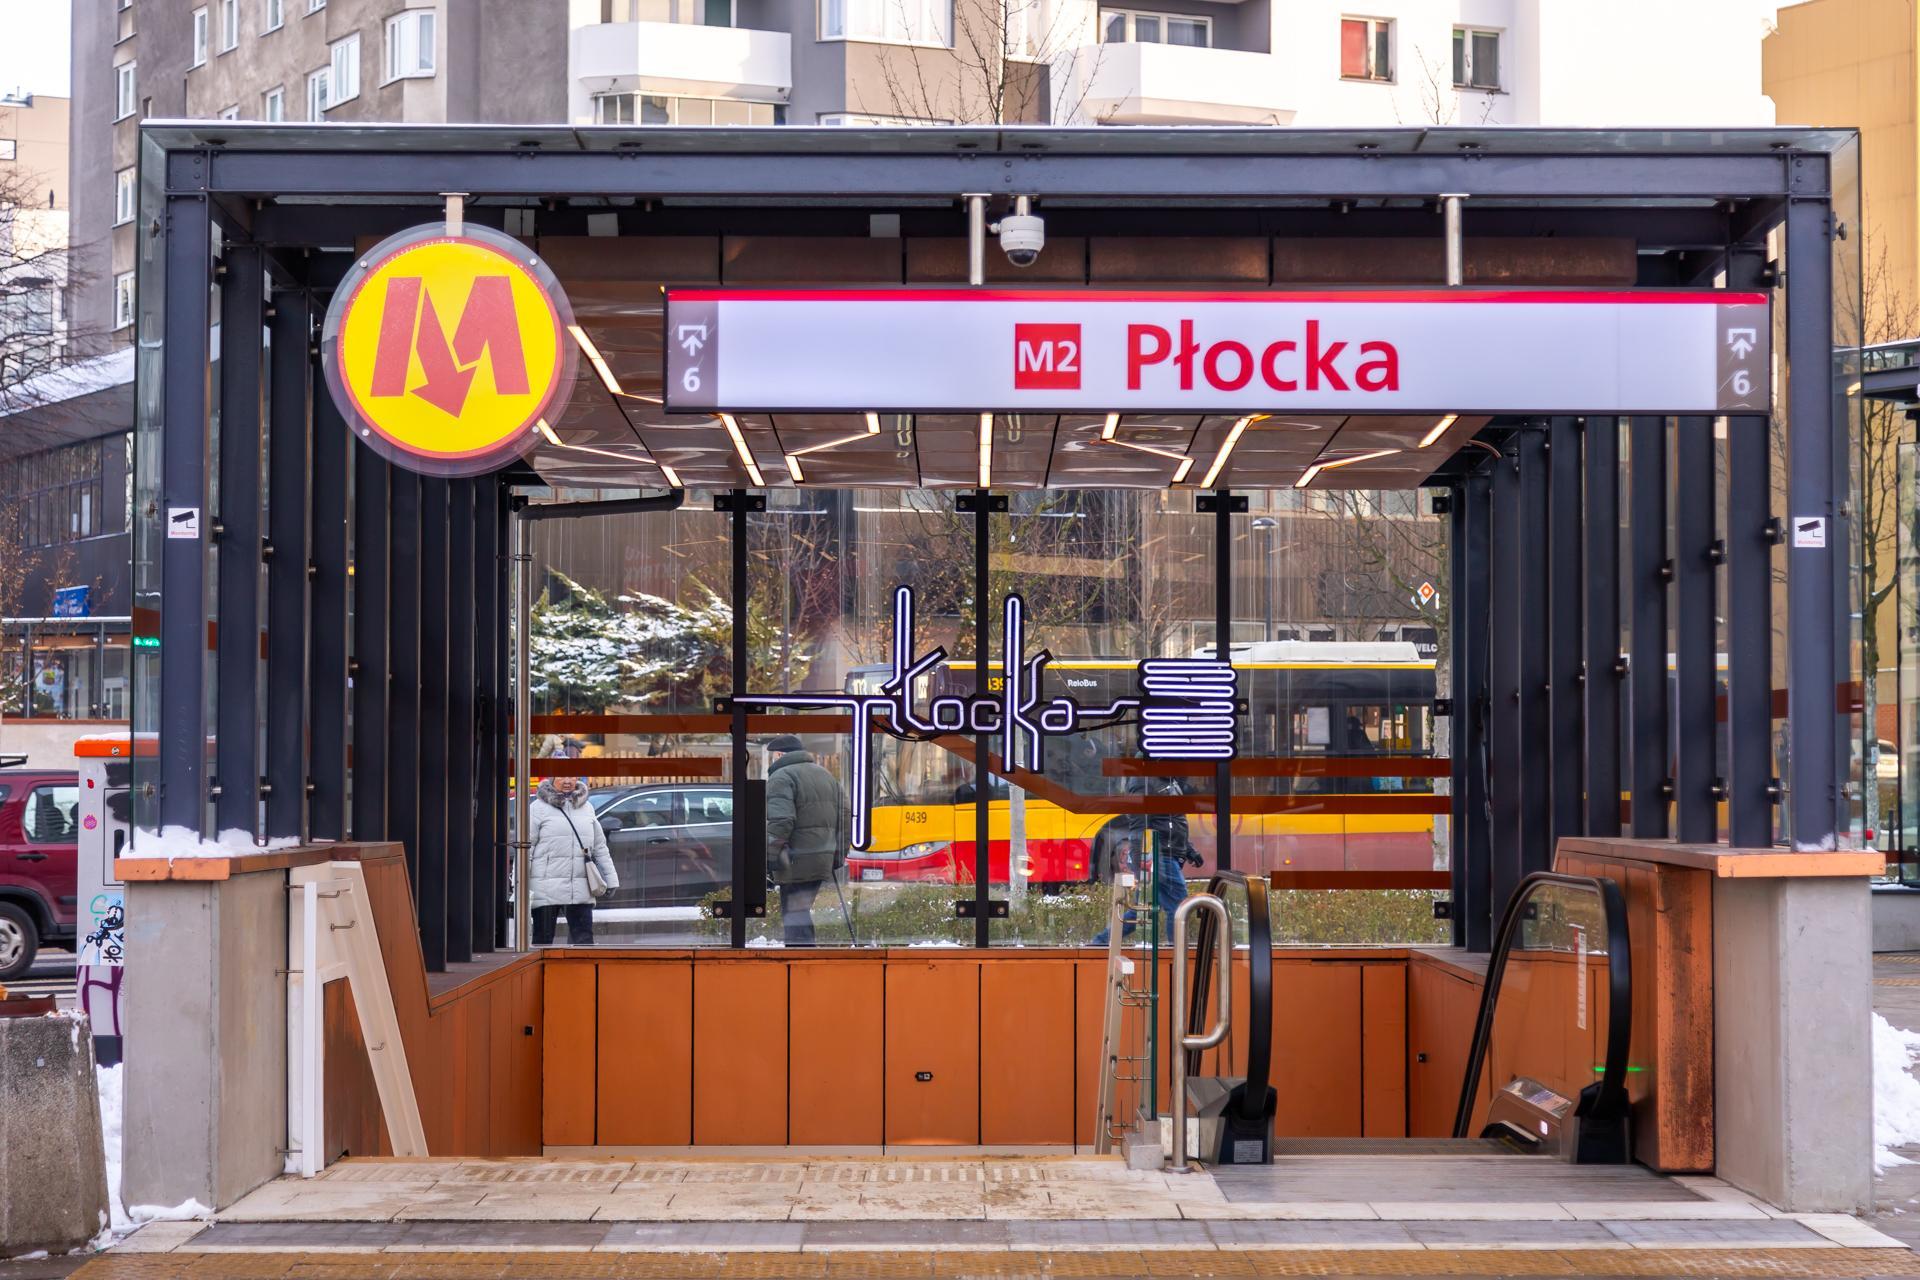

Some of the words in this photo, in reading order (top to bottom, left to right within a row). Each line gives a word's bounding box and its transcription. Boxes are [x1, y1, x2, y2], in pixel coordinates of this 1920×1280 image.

[370, 275, 531, 419] M
[1018, 340, 1079, 373] M2
[1127, 319, 1400, 392] Płocka
[683, 367, 701, 392] 6
[1733, 370, 1751, 395] 6
[905, 811, 928, 824] 9439
